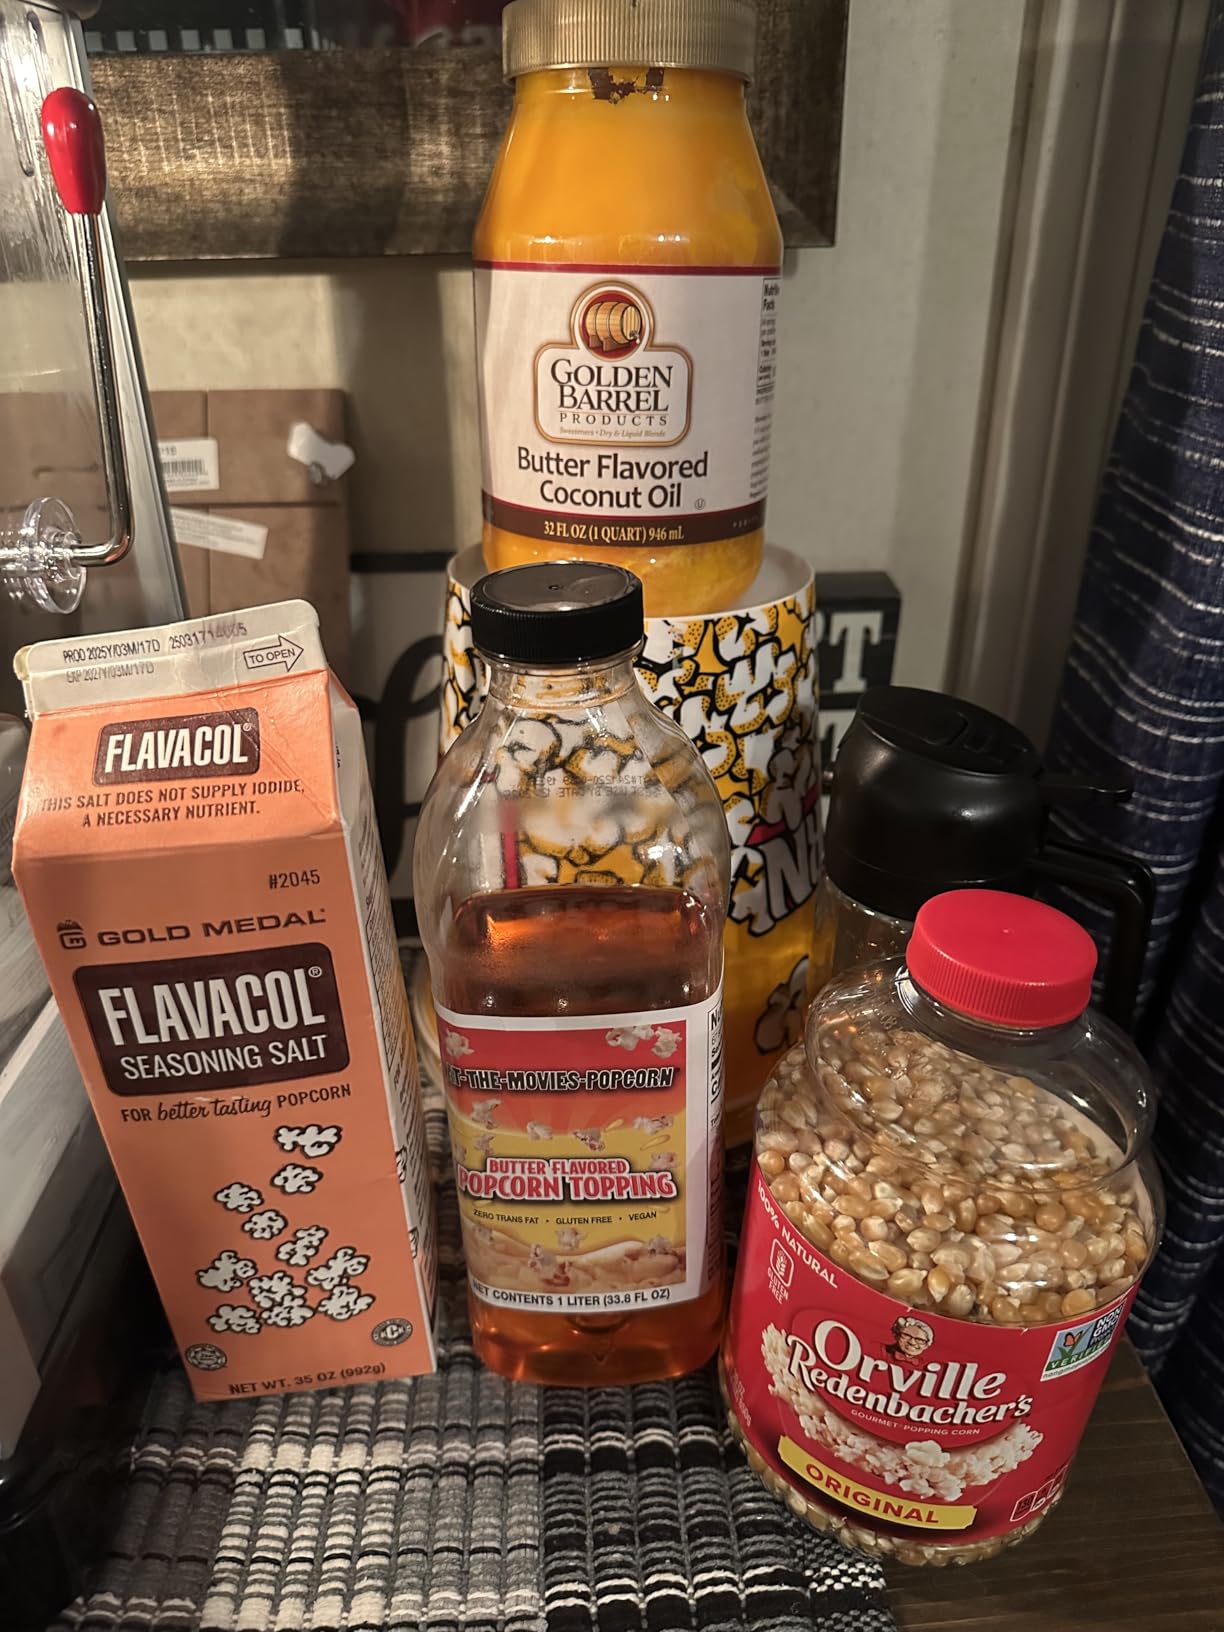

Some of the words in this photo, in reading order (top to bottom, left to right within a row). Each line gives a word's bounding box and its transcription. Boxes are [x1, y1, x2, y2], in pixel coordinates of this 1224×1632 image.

[551, 358, 673, 389] GOLDEN
[558, 384, 669, 413] BARREL
[560, 412, 667, 426] PRODUCTS
[600, 429, 613, 438] Dry
[621, 430, 643, 439] Liquid
[518, 446, 590, 478] Butter
[598, 450, 709, 480] Flavored
[540, 480, 642, 508] Coconut
[648, 482, 682, 508] Oil
[544, 520, 555, 535] 32
[557, 523, 569, 537] FL
[573, 524, 587, 539] OZ
[589, 525, 599, 541] (1
[601, 526, 647, 543] QUART)
[649, 527, 667, 540] 946
[668, 525, 684, 539] mL
[63, 650, 86, 663] PROD
[250, 653, 264, 664] TO
[266, 648, 296, 662] OPEN
[40, 795, 72, 812] THIS
[77, 792, 112, 809] SALT
[115, 790, 153, 806] DOES
[158, 787, 188, 803] NOT
[191, 782, 247, 800] SUPPLY
[252, 779, 305, 796] IODIDE,
[82, 814, 92, 828] A
[97, 807, 180, 827] NECESSARY
[186, 800, 261, 818] NUTRIENT.
[268, 869, 321, 890] #2045
[97, 924, 191, 947] GOLD
[202, 908, 326, 938] MEDAL
[120, 1044, 263, 1080] SEASONING
[268, 1034, 328, 1066] SALT
[121, 1107, 153, 1122] FOR
[157, 1101, 210, 1121] better
[211, 1096, 272, 1118] tasting
[276, 1083, 352, 1108] POPCORN
[488, 1158, 547, 1175] BUTTER
[551, 1158, 628, 1175] FLAVORED
[458, 1165, 562, 1199] POPCORN
[567, 1172, 676, 1199] TOPPING
[473, 1208, 494, 1220] ZERO
[496, 1214, 523, 1224] TRANS
[525, 1216, 539, 1224] FAT
[556, 1216, 589, 1225] GLUTEN
[591, 1216, 613, 1224] FREE
[628, 1211, 657, 1221] VEGAN
[758, 1179, 780, 1229] 100%
[781, 1226, 838, 1289] NATURAL
[472, 1280, 490, 1297] NET
[493, 1289, 554, 1306] CONTENTS
[558, 1297, 563, 1306] 1
[567, 1294, 601, 1306] LITER
[603, 1292, 632, 1307] (33.8
[634, 1291, 649, 1303] FL
[651, 1288, 671, 1300] OZ)
[767, 1267, 789, 1301] GLUTEN
[768, 1281, 783, 1305] FREE
[813, 1319, 1007, 1400] Orville
[229, 1383, 258, 1396] NET
[261, 1378, 291, 1391] WT.
[295, 1374, 313, 1386] 35
[317, 1370, 337, 1382] OZ
[340, 1362, 387, 1380] (992g)
[785, 1334, 1034, 1425] Redenbacher's
[851, 1408, 898, 1429] GOURMET
[903, 1424, 949, 1436] POPPING
[951, 1428, 981, 1436] CORN
[805, 1462, 940, 1525] ORIGINAL
